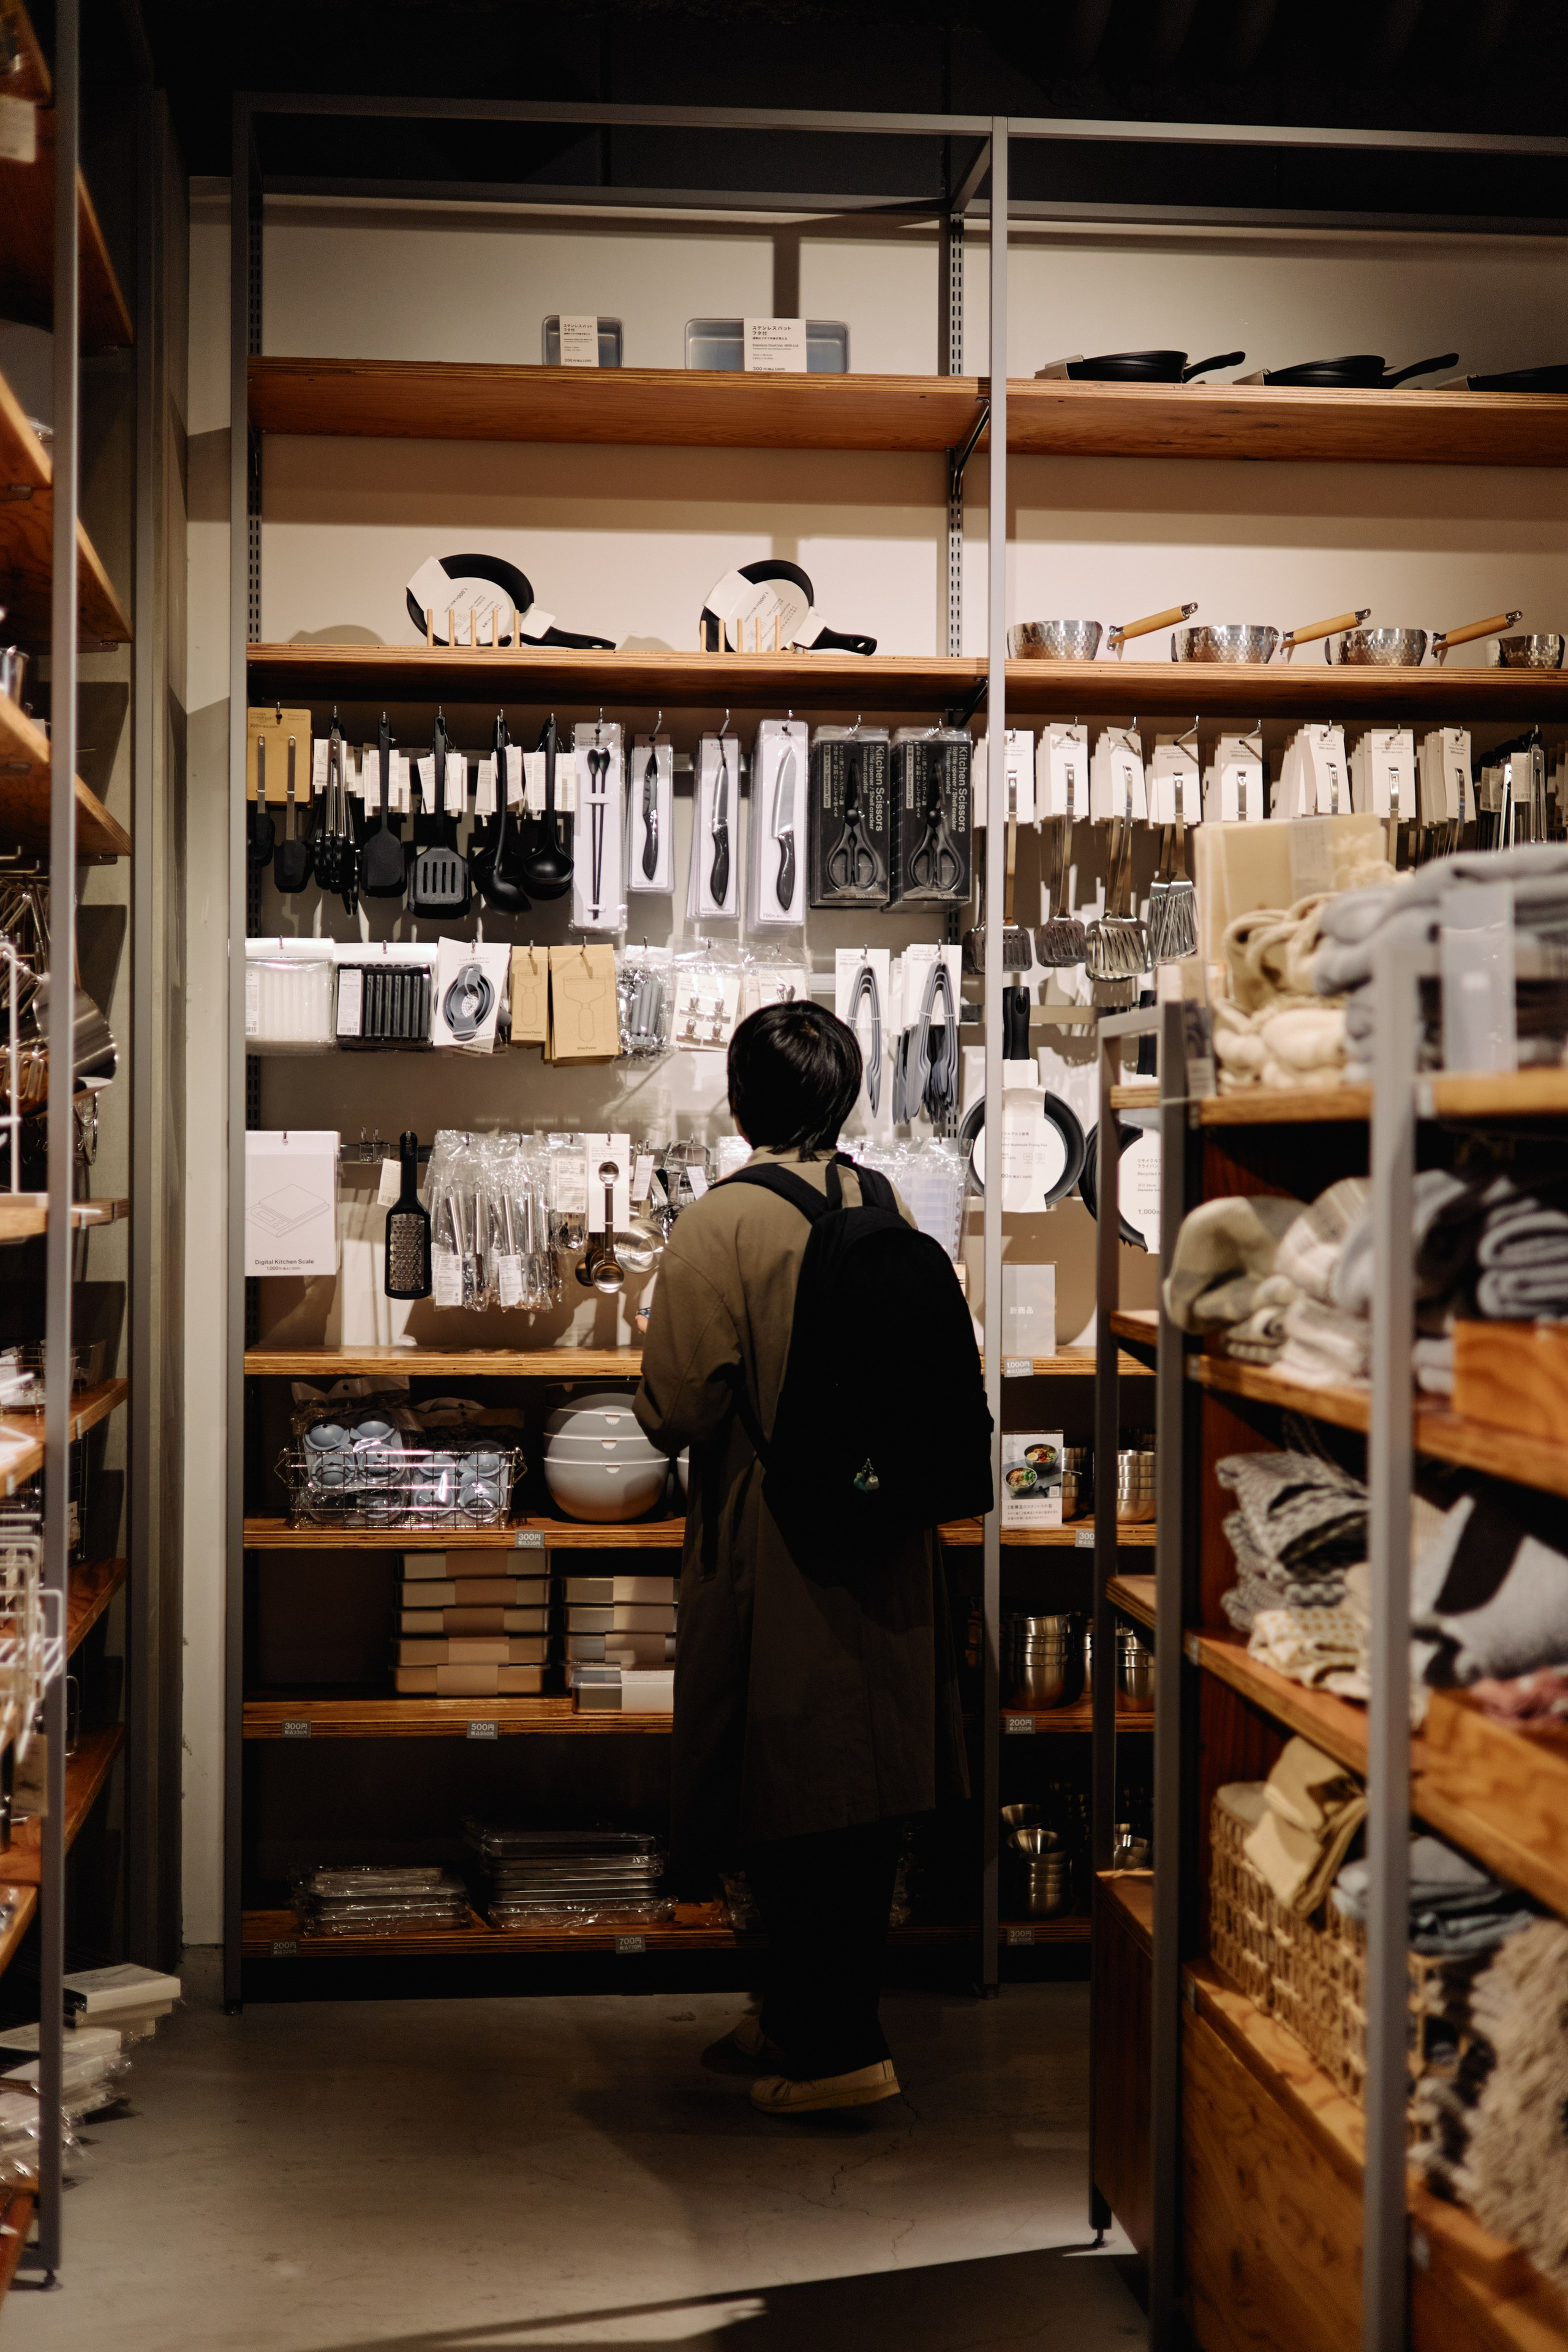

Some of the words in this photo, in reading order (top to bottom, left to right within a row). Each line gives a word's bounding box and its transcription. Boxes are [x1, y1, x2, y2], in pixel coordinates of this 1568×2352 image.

[876, 745, 885, 785] Kitchen
[959, 746, 968, 786] Kitchen
[875, 787, 885, 832] Scissors
[958, 788, 968, 832] Scissors
[1009, 1306, 1034, 1314] 新商品
[619, 1937, 642, 1945] 700円
